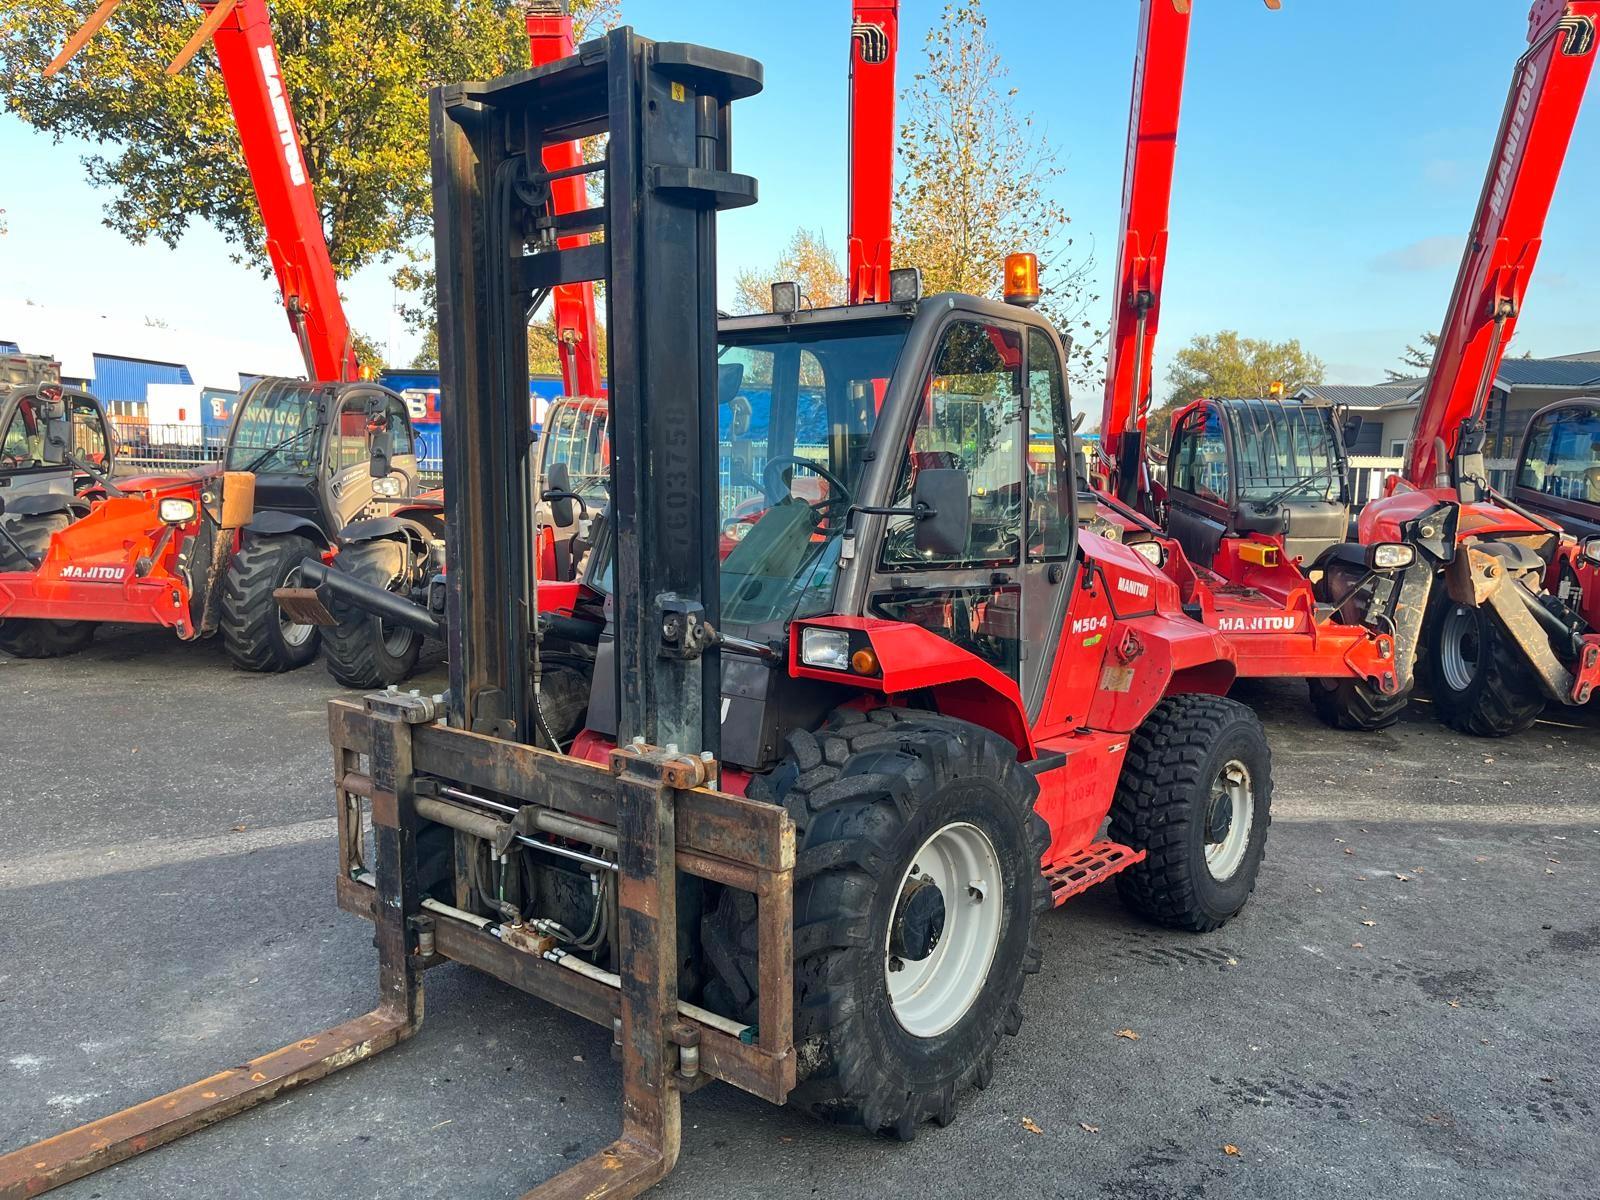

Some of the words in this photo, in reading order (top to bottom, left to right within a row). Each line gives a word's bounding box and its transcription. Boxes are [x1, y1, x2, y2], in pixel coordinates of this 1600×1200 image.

[1489, 60, 1537, 216] MANITOU
[1117, 577, 1149, 598] MANITOU
[1072, 615, 1107, 634] M50-4
